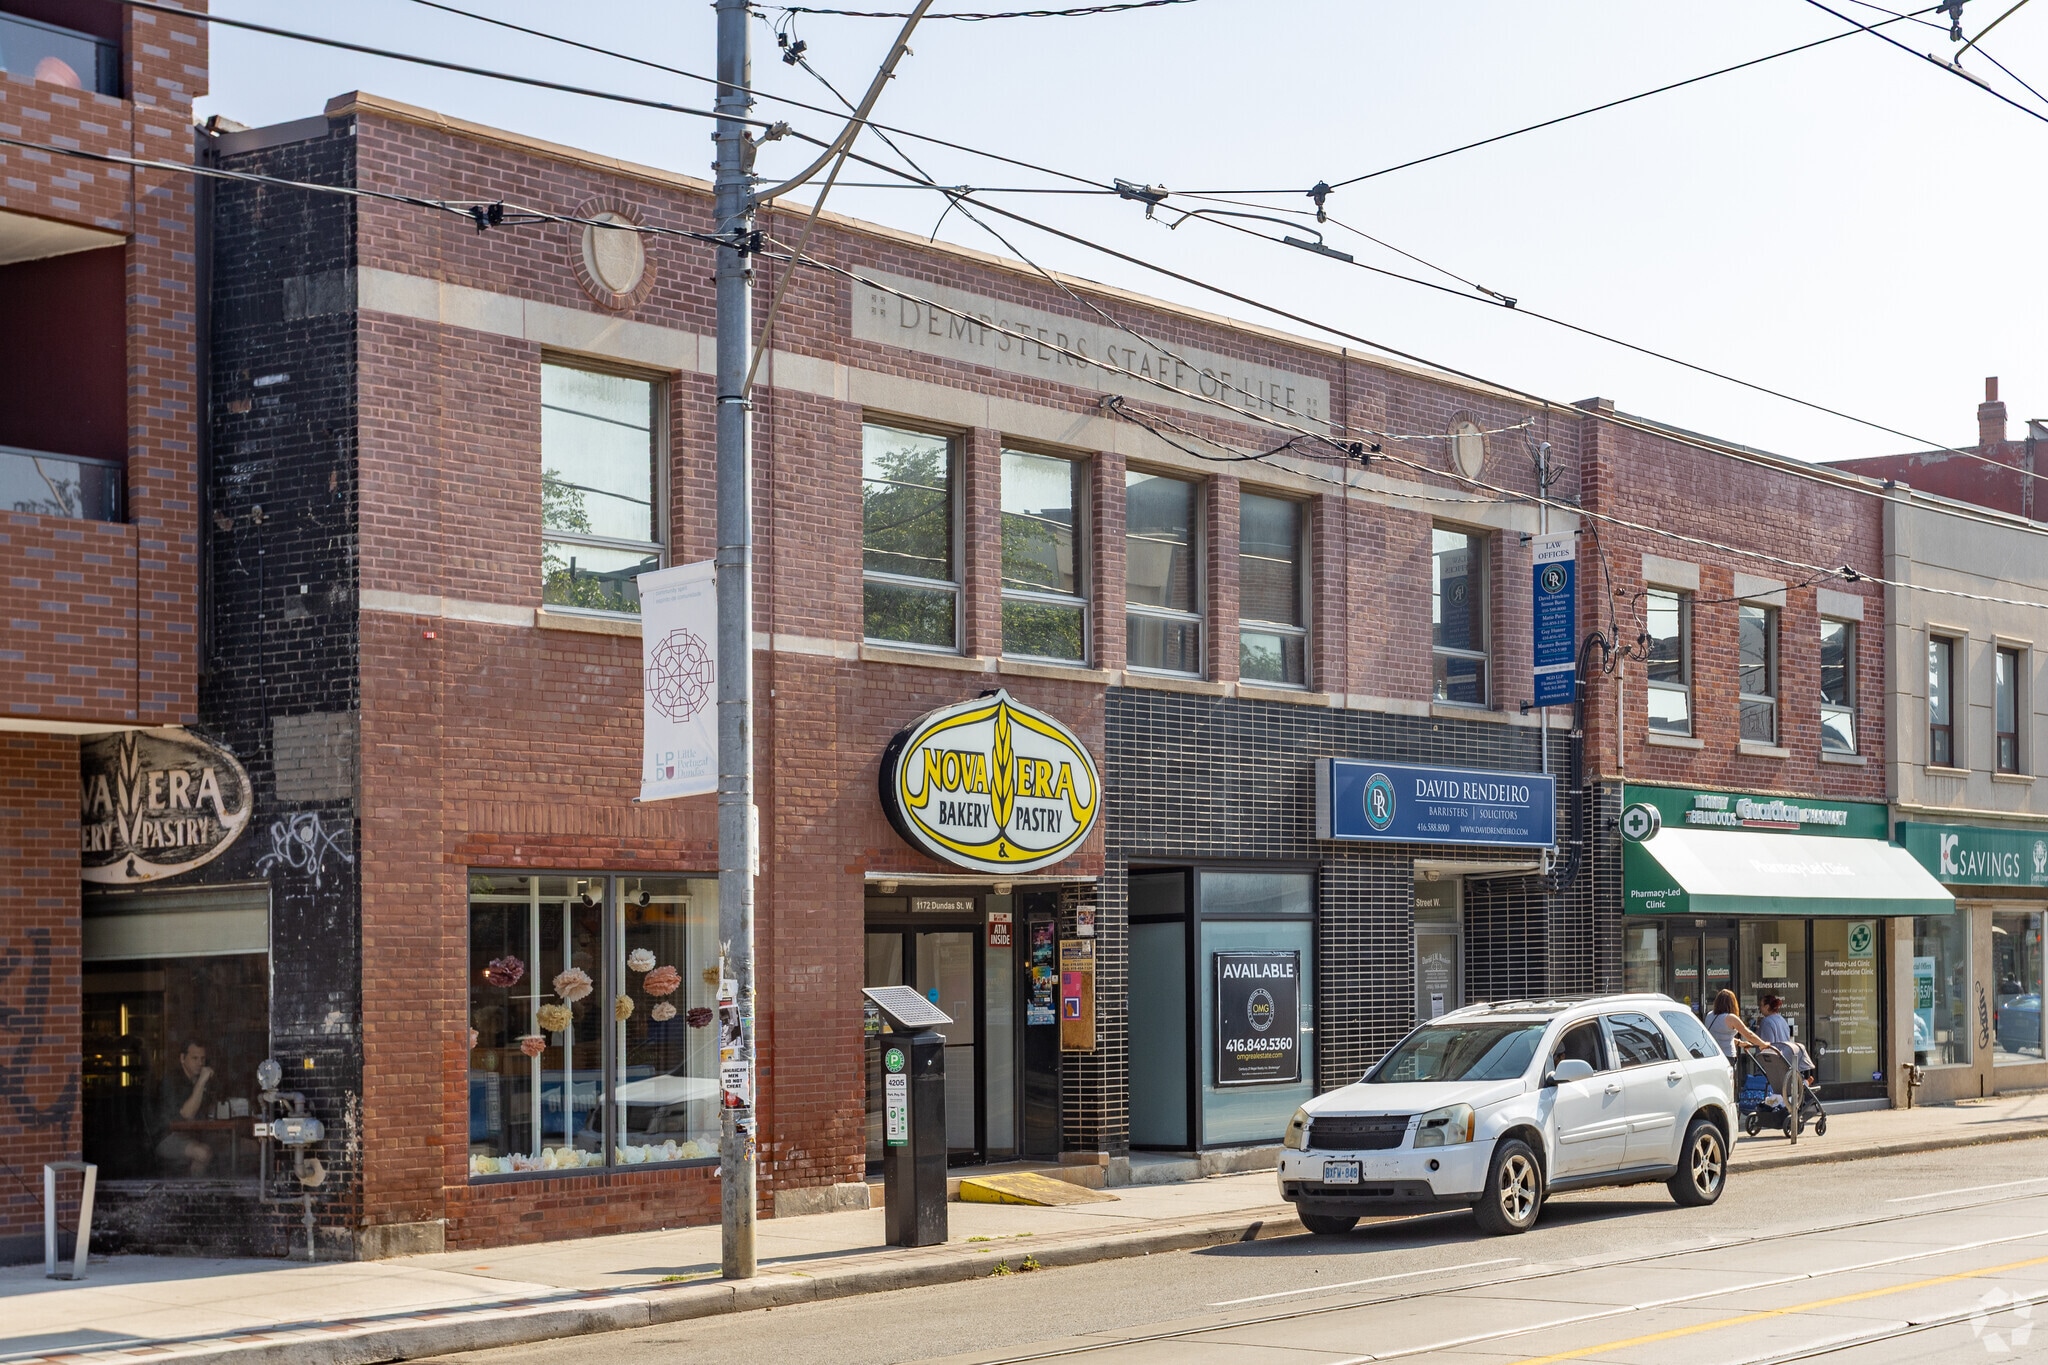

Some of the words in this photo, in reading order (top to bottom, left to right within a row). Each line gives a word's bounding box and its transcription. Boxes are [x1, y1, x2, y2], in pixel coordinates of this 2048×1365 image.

[899, 297, 1089, 370] DEMPSTERS
[1108, 344, 1184, 389] STAFF
[1199, 367, 1232, 400] OF
[1243, 376, 1296, 417] LIFE
[1546, 542, 1561, 550] LAW
[1538, 550, 1570, 560] OFFICES
[919, 748, 990, 799] NOVA
[1015, 756, 1076, 806] ERA
[81, 774, 113, 815] VA
[147, 768, 229, 823] ERA
[1415, 778, 1460, 799] DAVID
[1463, 782, 1530, 803] RENDEIRO
[1695, 795, 1729, 810] TRINITY
[939, 800, 990, 828] BAKERY
[1016, 806, 1063, 833] PASTRY
[1428, 806, 1468, 817] BARRISTERS
[1480, 809, 1518, 820] SOLICITORS
[1690, 811, 1736, 826] BELLWOODS
[1736, 798, 1800, 819] Guardian
[1803, 809, 1848, 825] PHARMACY
[82, 822, 113, 851] ERY
[142, 817, 210, 848] PASTRY
[1417, 823, 1450, 832] 416.588.8000
[1460, 825, 1529, 836] WWW.DAVIDRENDEIRO.COM
[998, 842, 1009, 858] &
[1960, 850, 2020, 878] SAVINGS
[1631, 888, 1680, 898] Pharmacy-Led
[916, 900, 931, 910] 1172
[932, 901, 955, 910] Dundas
[956, 901, 965, 910] St.
[965, 901, 973, 910] W.
[1416, 898, 1432, 907] Street
[1434, 898, 1440, 907] W.
[1646, 900, 1666, 909] Clinic
[994, 924, 1007, 934] ATM
[991, 935, 1010, 945] INSIDE
[1223, 964, 1294, 978] AVAILABLE
[1675, 968, 1698, 976] Guardian
[1707, 968, 1729, 976] Guardian
[1252, 1004, 1269, 1013] OMG
[1226, 1038, 1292, 1052] 416.849.5360
[891, 1055, 899, 1064] P
[1237, 1052, 1283, 1061] omgrealestate.com
